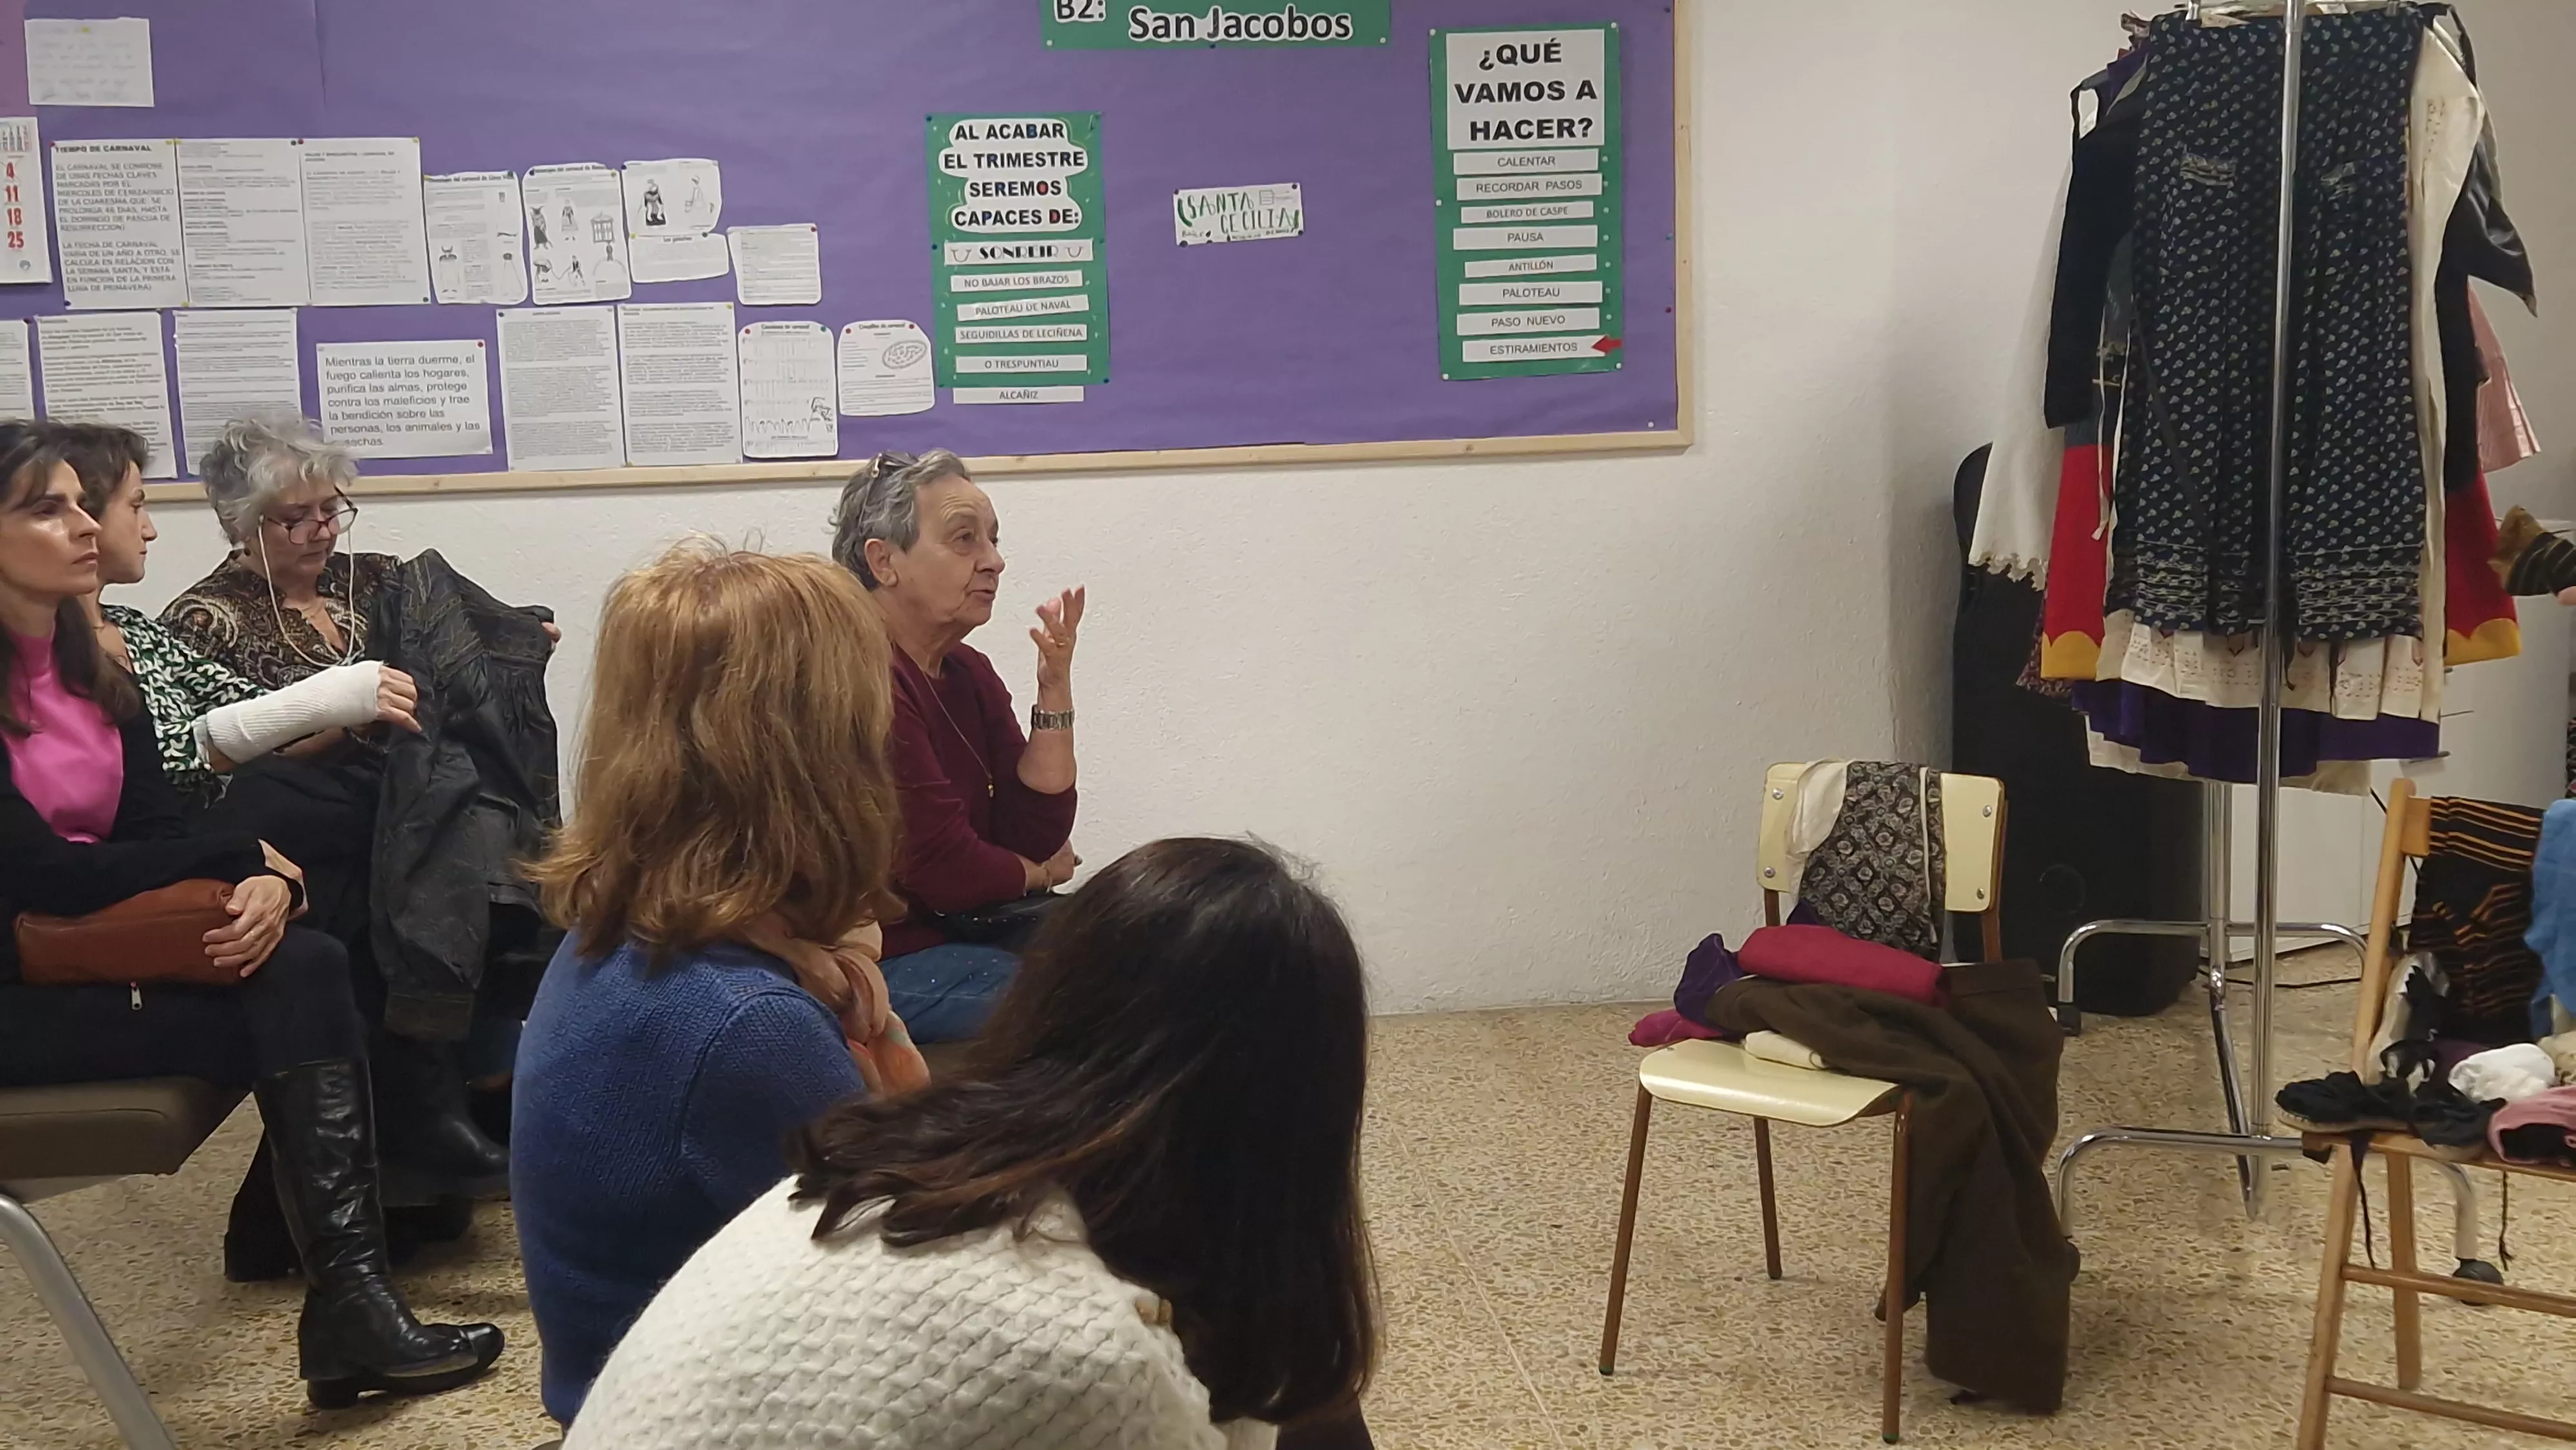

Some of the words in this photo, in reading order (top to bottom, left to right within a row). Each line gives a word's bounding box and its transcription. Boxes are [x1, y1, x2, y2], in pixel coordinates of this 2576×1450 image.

[1057, 0, 1104, 19] B2:
[1130, 8, 1195, 39] San
[1207, 6, 1350, 39] Jacobos
[1479, 37, 1562, 70] ¿QUÉ
[1454, 80, 1566, 103] VAMOS
[1575, 79, 1598, 100] A
[955, 126, 980, 140] AL
[985, 123, 1065, 139] ACABAR
[1470, 117, 1593, 141] HACER?
[944, 154, 967, 169] EL
[973, 151, 1084, 169] TRIMESTRE
[1497, 156, 1556, 167] CALENTAR
[6, 162, 14, 178] 4
[6, 185, 18, 202] 11
[969, 180, 1061, 197] SEREMOS
[1476, 182, 1539, 193] RECORDAR
[1546, 180, 1582, 190] PASOS
[1187, 192, 1255, 220] SANTA
[1486, 209, 1522, 218] BOLERO
[1526, 207, 1537, 216] DE
[1540, 206, 1569, 216] CASPE
[7, 207, 22, 225] 18
[954, 209, 1042, 226] CAPACES
[1049, 209, 1079, 224] DE:
[1220, 207, 1294, 234] CECILIA
[8, 231, 24, 249] 25
[1507, 232, 1544, 243] PAUSA
[979, 245, 1059, 260] SONREIR
[1508, 259, 1553, 271] ANTILLÓN
[964, 279, 979, 287] NO
[982, 278, 1010, 287] BAJAR
[1013, 277, 1030, 285] LOS
[1033, 275, 1070, 285] BRAZOS
[1502, 288, 1560, 298] PALOTEAU
[975, 306, 1023, 315] PALOTEAU
[1026, 303, 1038, 312] DE
[1041, 300, 1071, 310] NAVAL
[1492, 317, 1520, 327] PASO
[1527, 315, 1566, 325] NUEVO
[960, 330, 1019, 340] SEGUIDILLAS
[1023, 329, 1034, 338] DE
[1037, 327, 1083, 338] LECIÑENA
[1490, 343, 1578, 355] ESTIRAMIENTOS
[325, 357, 372, 366] Mientras
[375, 356, 384, 366] la
[387, 355, 415, 366] tierra
[418, 355, 462, 365] duerme,
[465, 354, 475, 364] el
[995, 360, 1059, 368] TRESPUNTIAU
[327, 371, 356, 382] fuego
[359, 370, 401, 379] calienta
[404, 369, 420, 379] los
[327, 384, 366, 396] purifica
[369, 383, 384, 393] las
[388, 382, 423, 393] almas,
[426, 382, 467, 393] protege
[999, 390, 1039, 400] ALCAÑIZ
[328, 399, 361, 407] contra
[365, 397, 380, 406] los
[383, 395, 437, 406] maleficios
[440, 396, 446, 407] y
[450, 395, 470, 404] trae
[329, 411, 339, 420] la
[341, 410, 393, 420] bendición
[397, 410, 426, 419] sobre
[430, 408, 445, 417] las
[330, 425, 383, 436] personas,
[386, 424, 401, 432] los
[405, 422, 452, 431] animales
[456, 422, 461, 433] y
[465, 420, 480, 431] las
